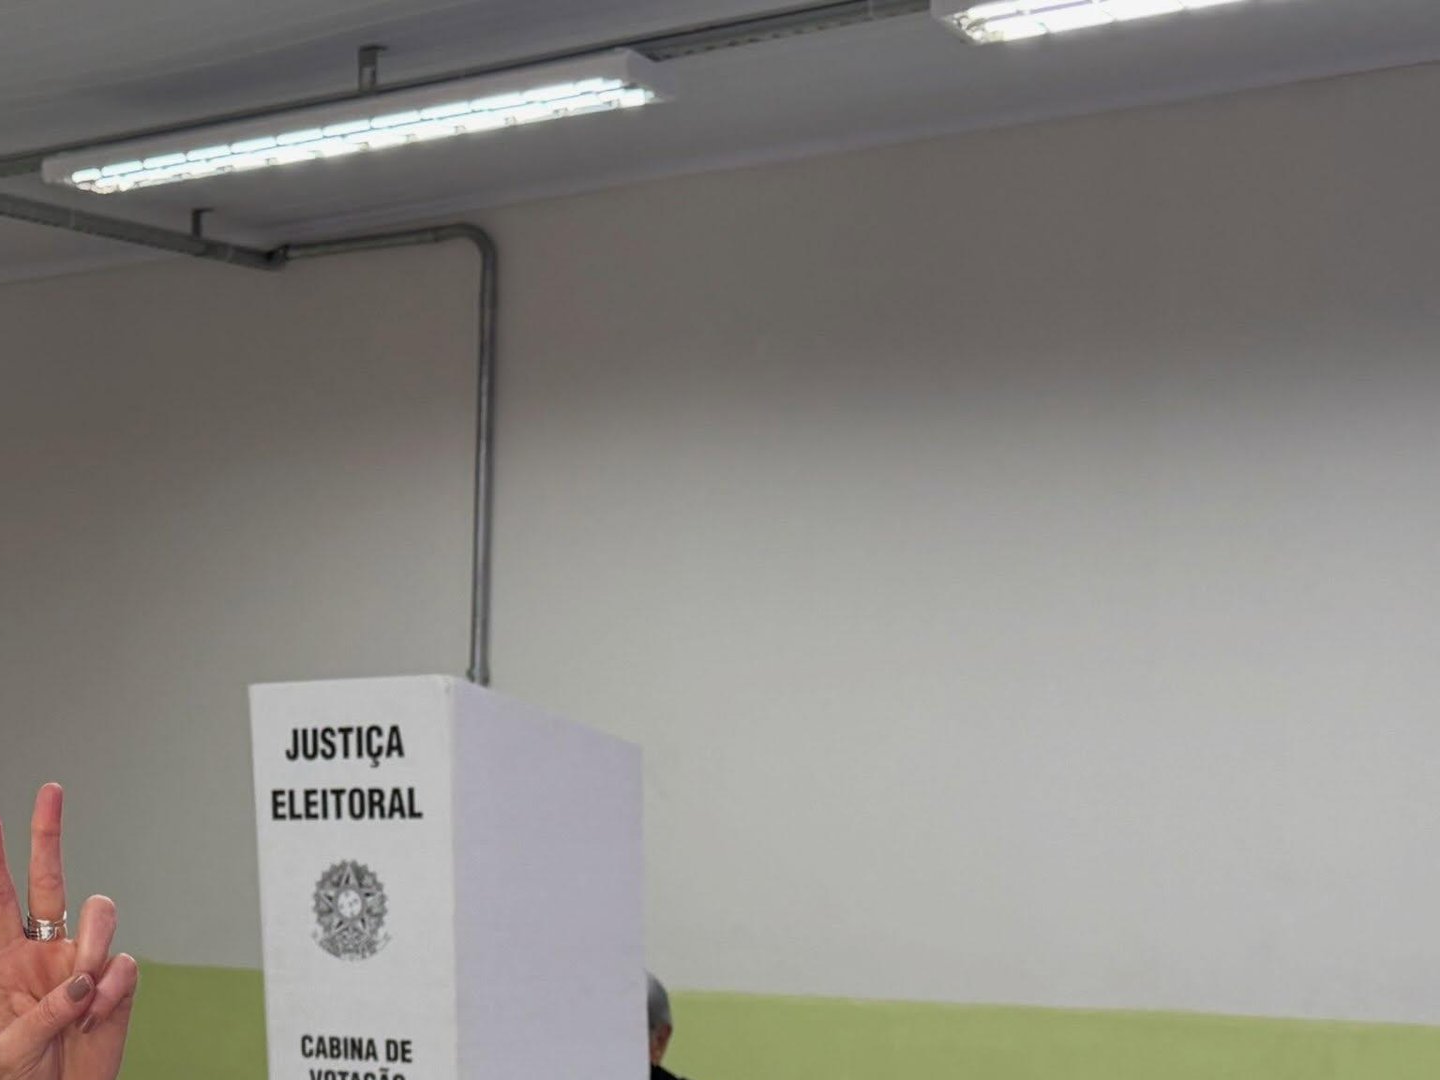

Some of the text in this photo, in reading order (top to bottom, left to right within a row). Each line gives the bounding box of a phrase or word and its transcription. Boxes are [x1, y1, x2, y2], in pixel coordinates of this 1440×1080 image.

[285, 725, 405, 768] JUSTIÇA
[271, 787, 423, 820] ELEITORAL
[301, 1035, 412, 1063] CABINA DE
